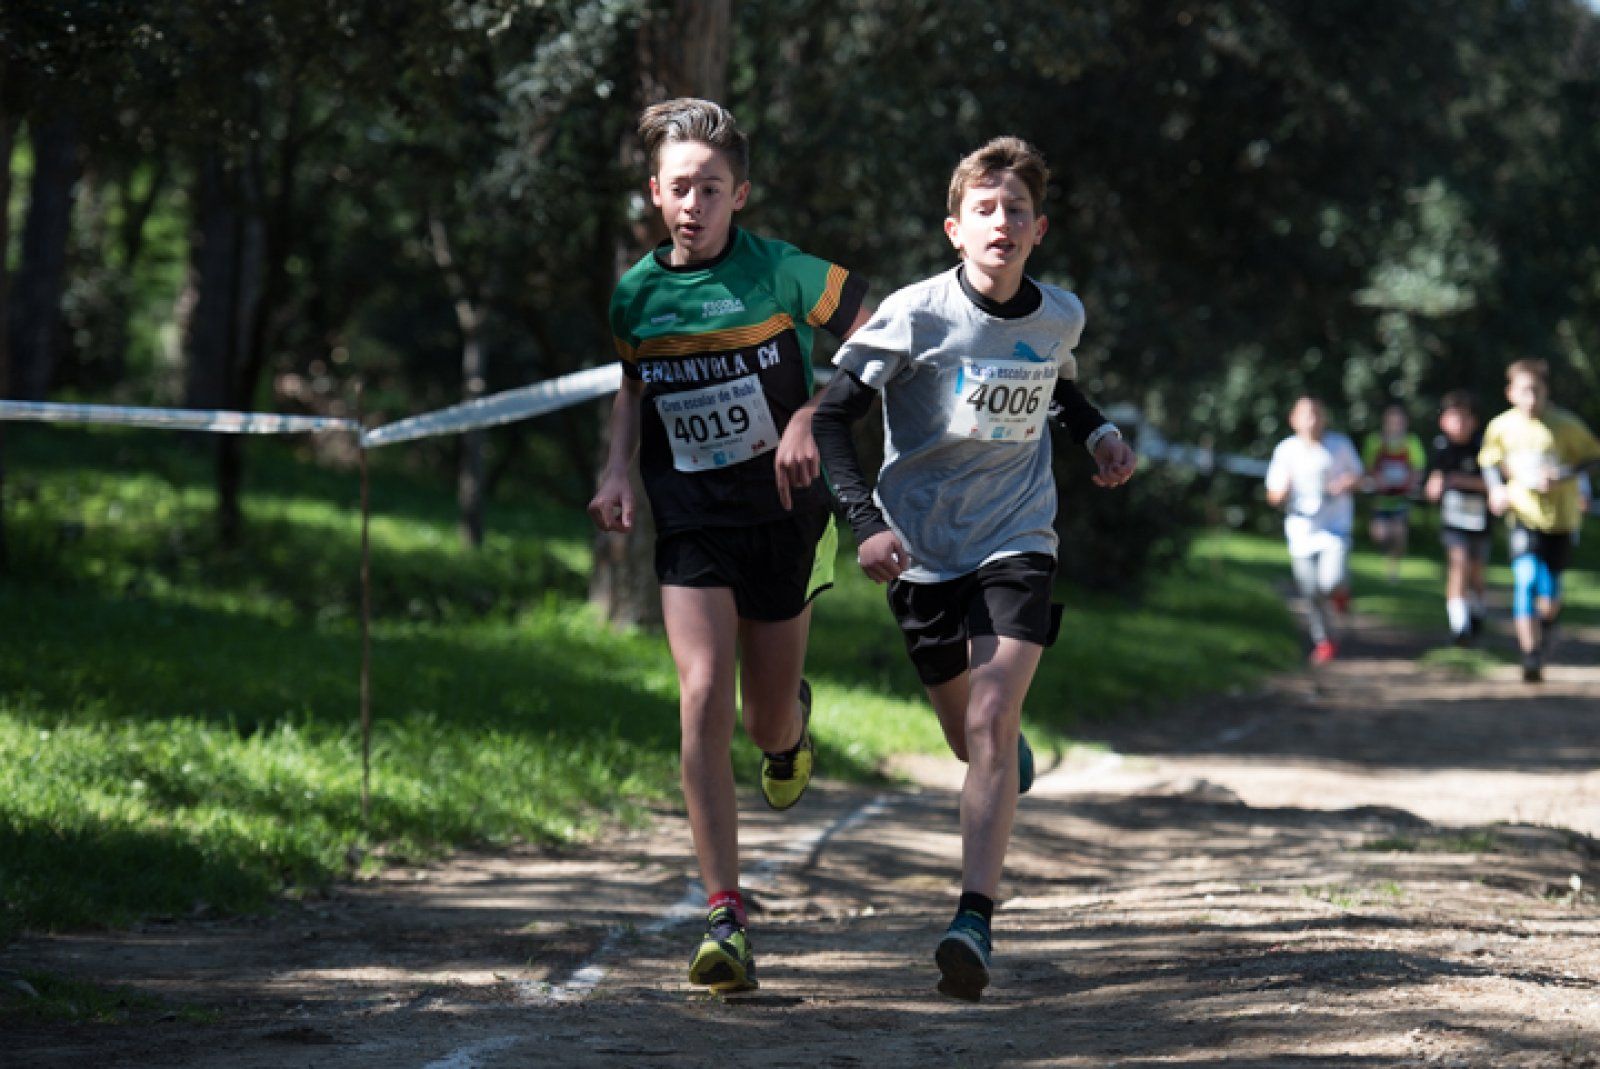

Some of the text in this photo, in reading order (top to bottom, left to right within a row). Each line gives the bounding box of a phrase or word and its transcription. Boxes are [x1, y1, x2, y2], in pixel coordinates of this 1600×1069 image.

[639, 354, 749, 382] ERDANYOLA
[719, 389, 731, 402] de
[967, 384, 1042, 415] 4006
[674, 405, 749, 444] 4019
